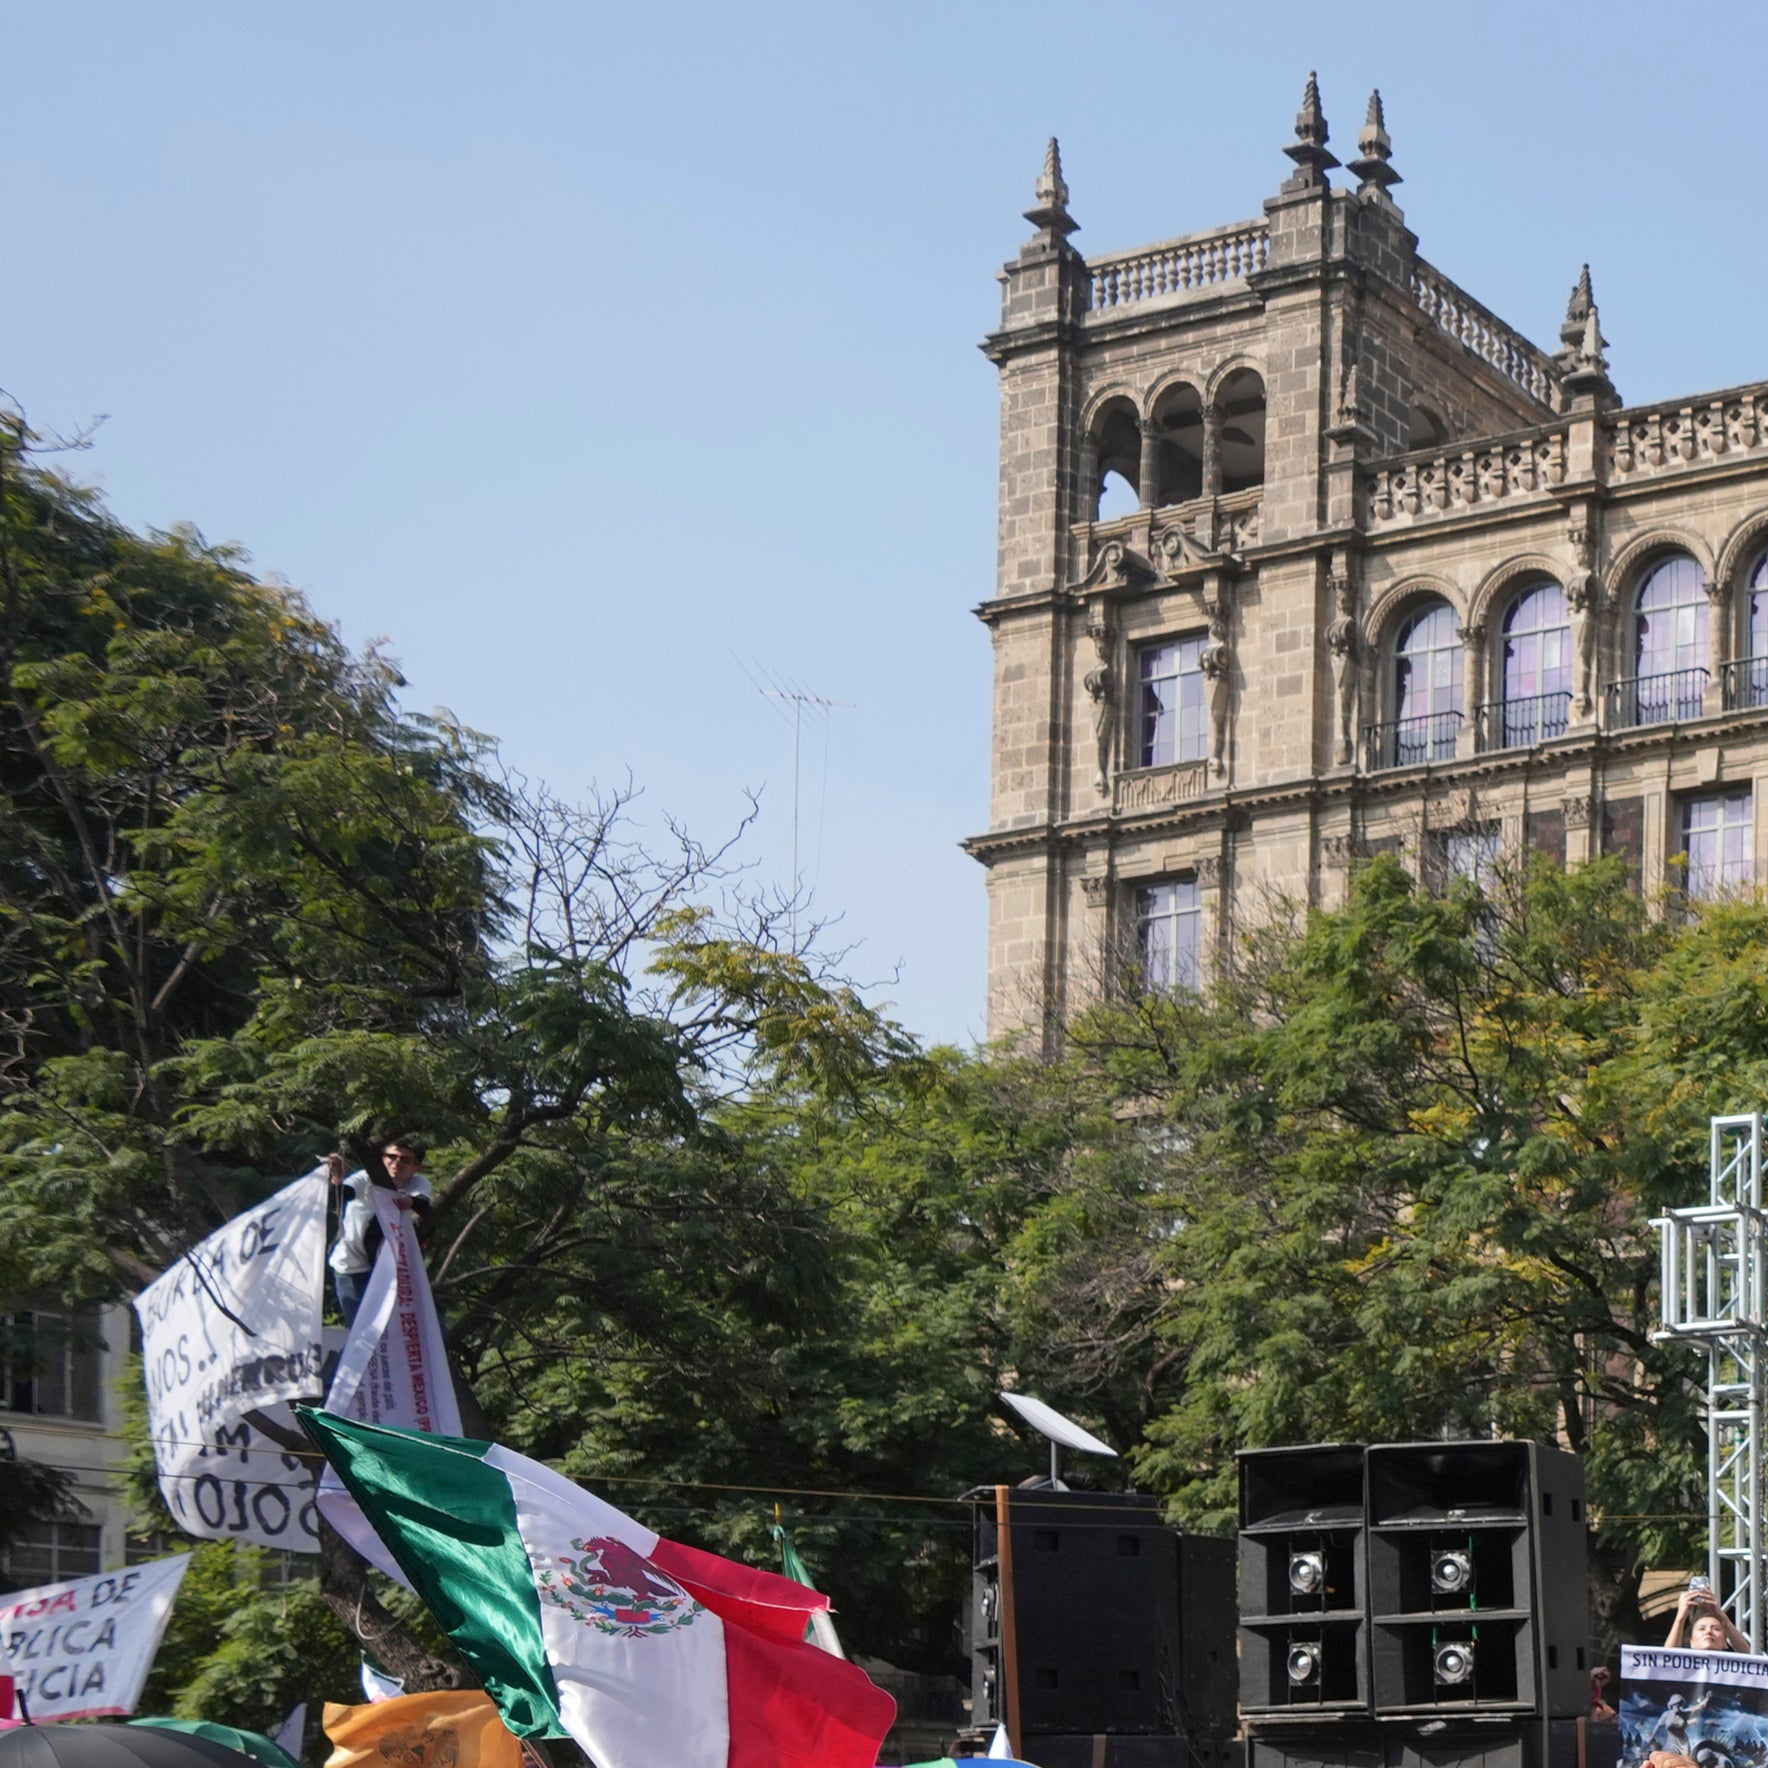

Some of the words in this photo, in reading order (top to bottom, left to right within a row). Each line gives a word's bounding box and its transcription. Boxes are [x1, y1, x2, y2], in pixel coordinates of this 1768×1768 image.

[400, 1313, 423, 1372] DESPIERTA
[90, 1571, 142, 1610] DE
[1632, 1653, 1659, 1669] SIN
[1662, 1655, 1711, 1671] PODER
